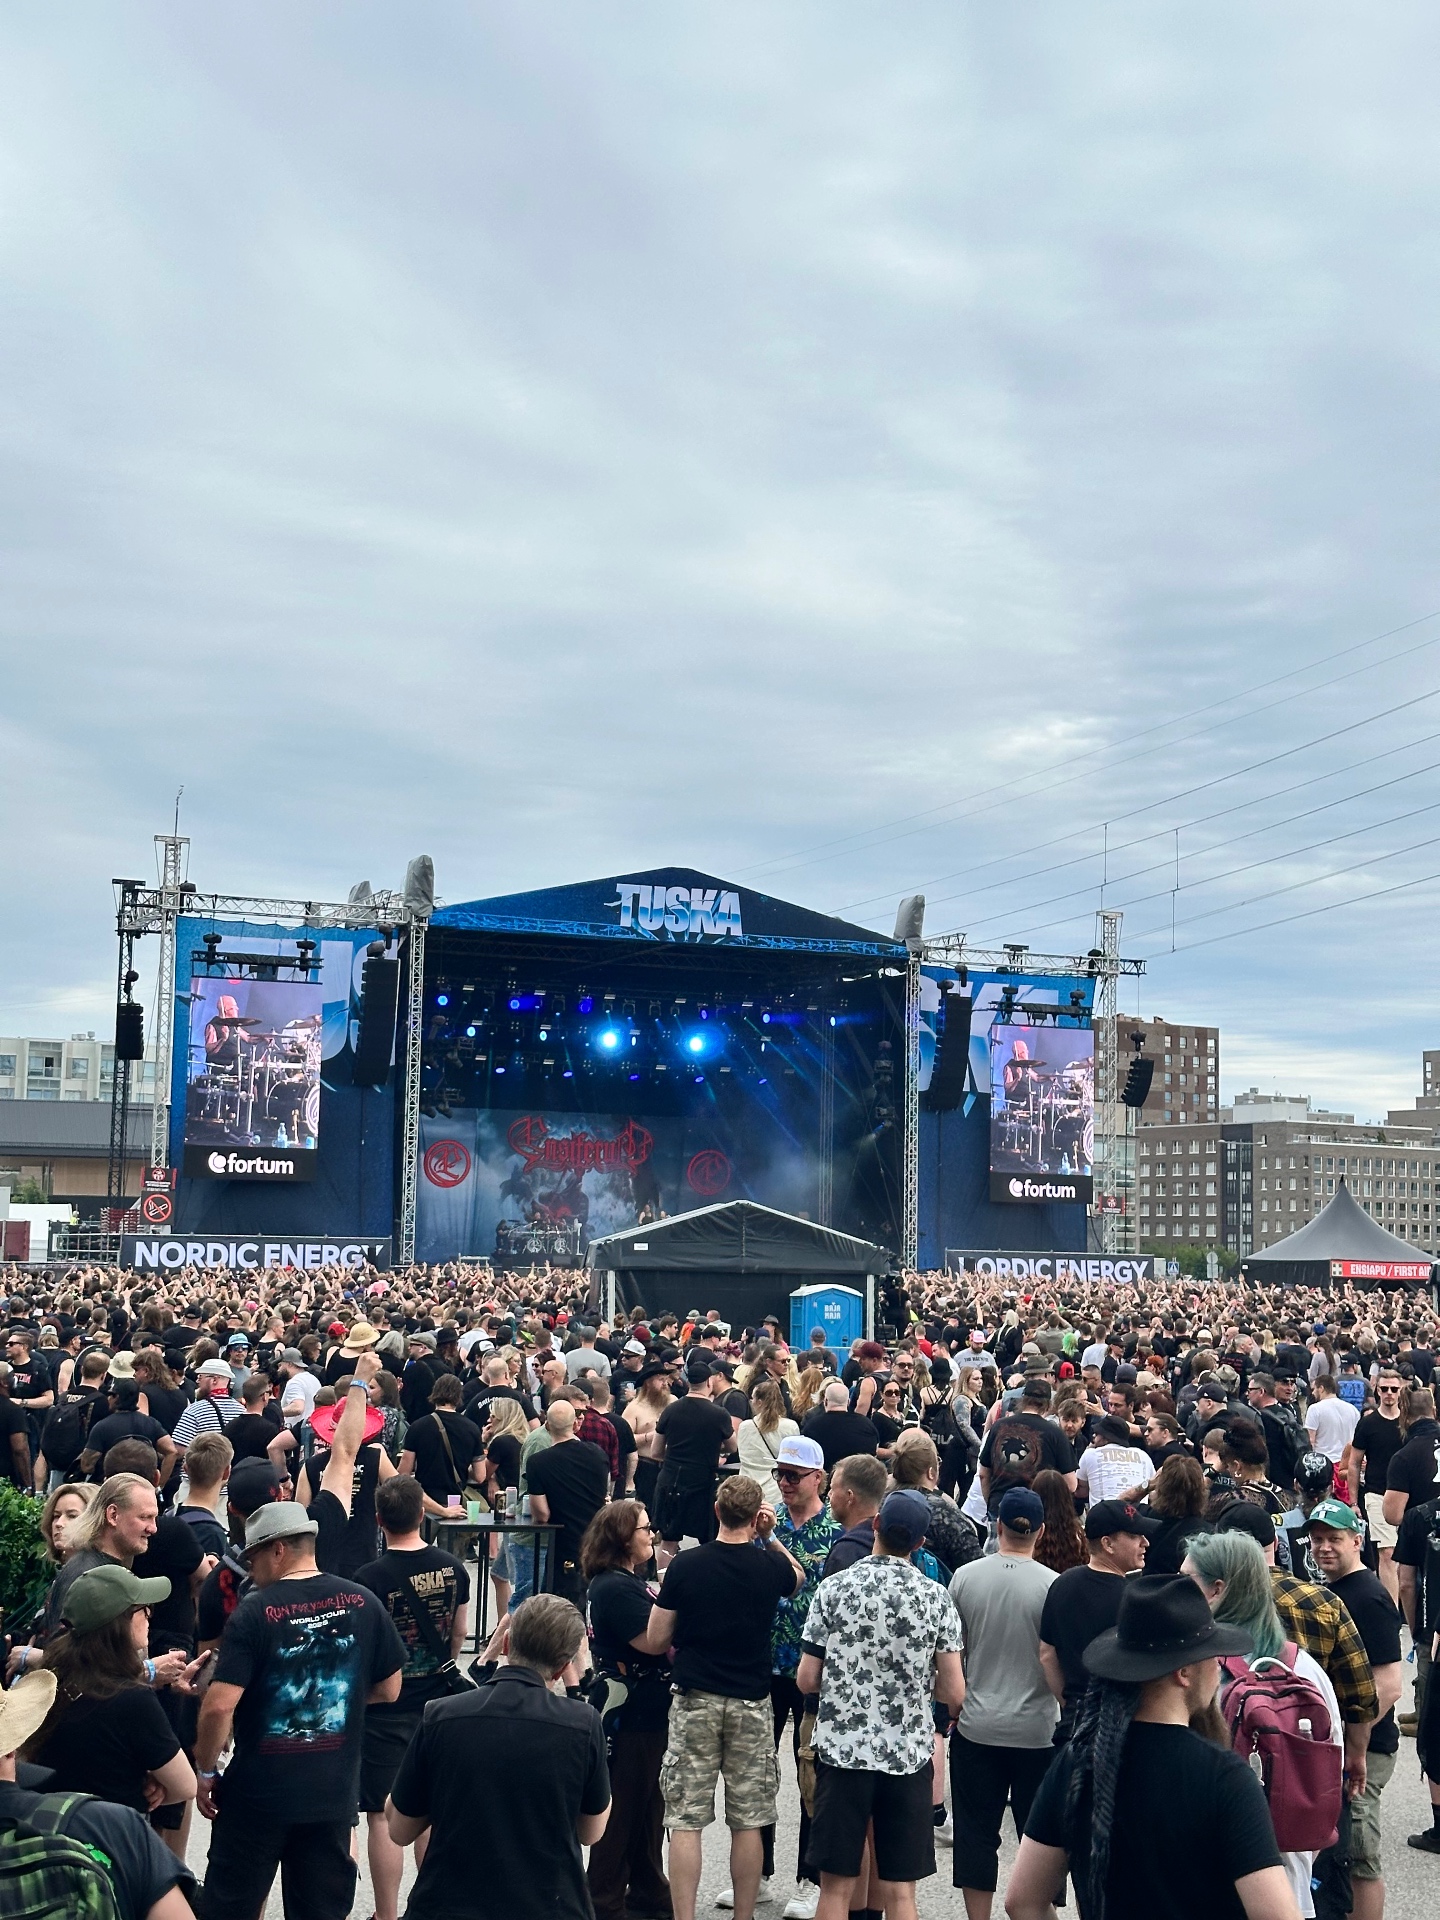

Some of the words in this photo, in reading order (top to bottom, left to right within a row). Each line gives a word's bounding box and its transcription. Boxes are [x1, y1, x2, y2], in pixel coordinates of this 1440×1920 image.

[616, 883, 743, 936] TUSKA
[228, 1153, 294, 1175] fortum
[1024, 1178, 1076, 1199] fortum
[134, 1241, 260, 1268] NORDIC
[1056, 1259, 1149, 1283] ENERGY
[1350, 1263, 1386, 1276] ENSIAPU
[1394, 1265, 1418, 1276] FIRST
[824, 1304, 841, 1312] BAJA
[824, 1312, 841, 1320] MAJA
[265, 1605, 290, 1622] RUN
[291, 1603, 311, 1614] FOR
[310, 1597, 336, 1613] YOUR
[290, 1616, 321, 1625] WORLD
[320, 1609, 346, 1620] TOUR
